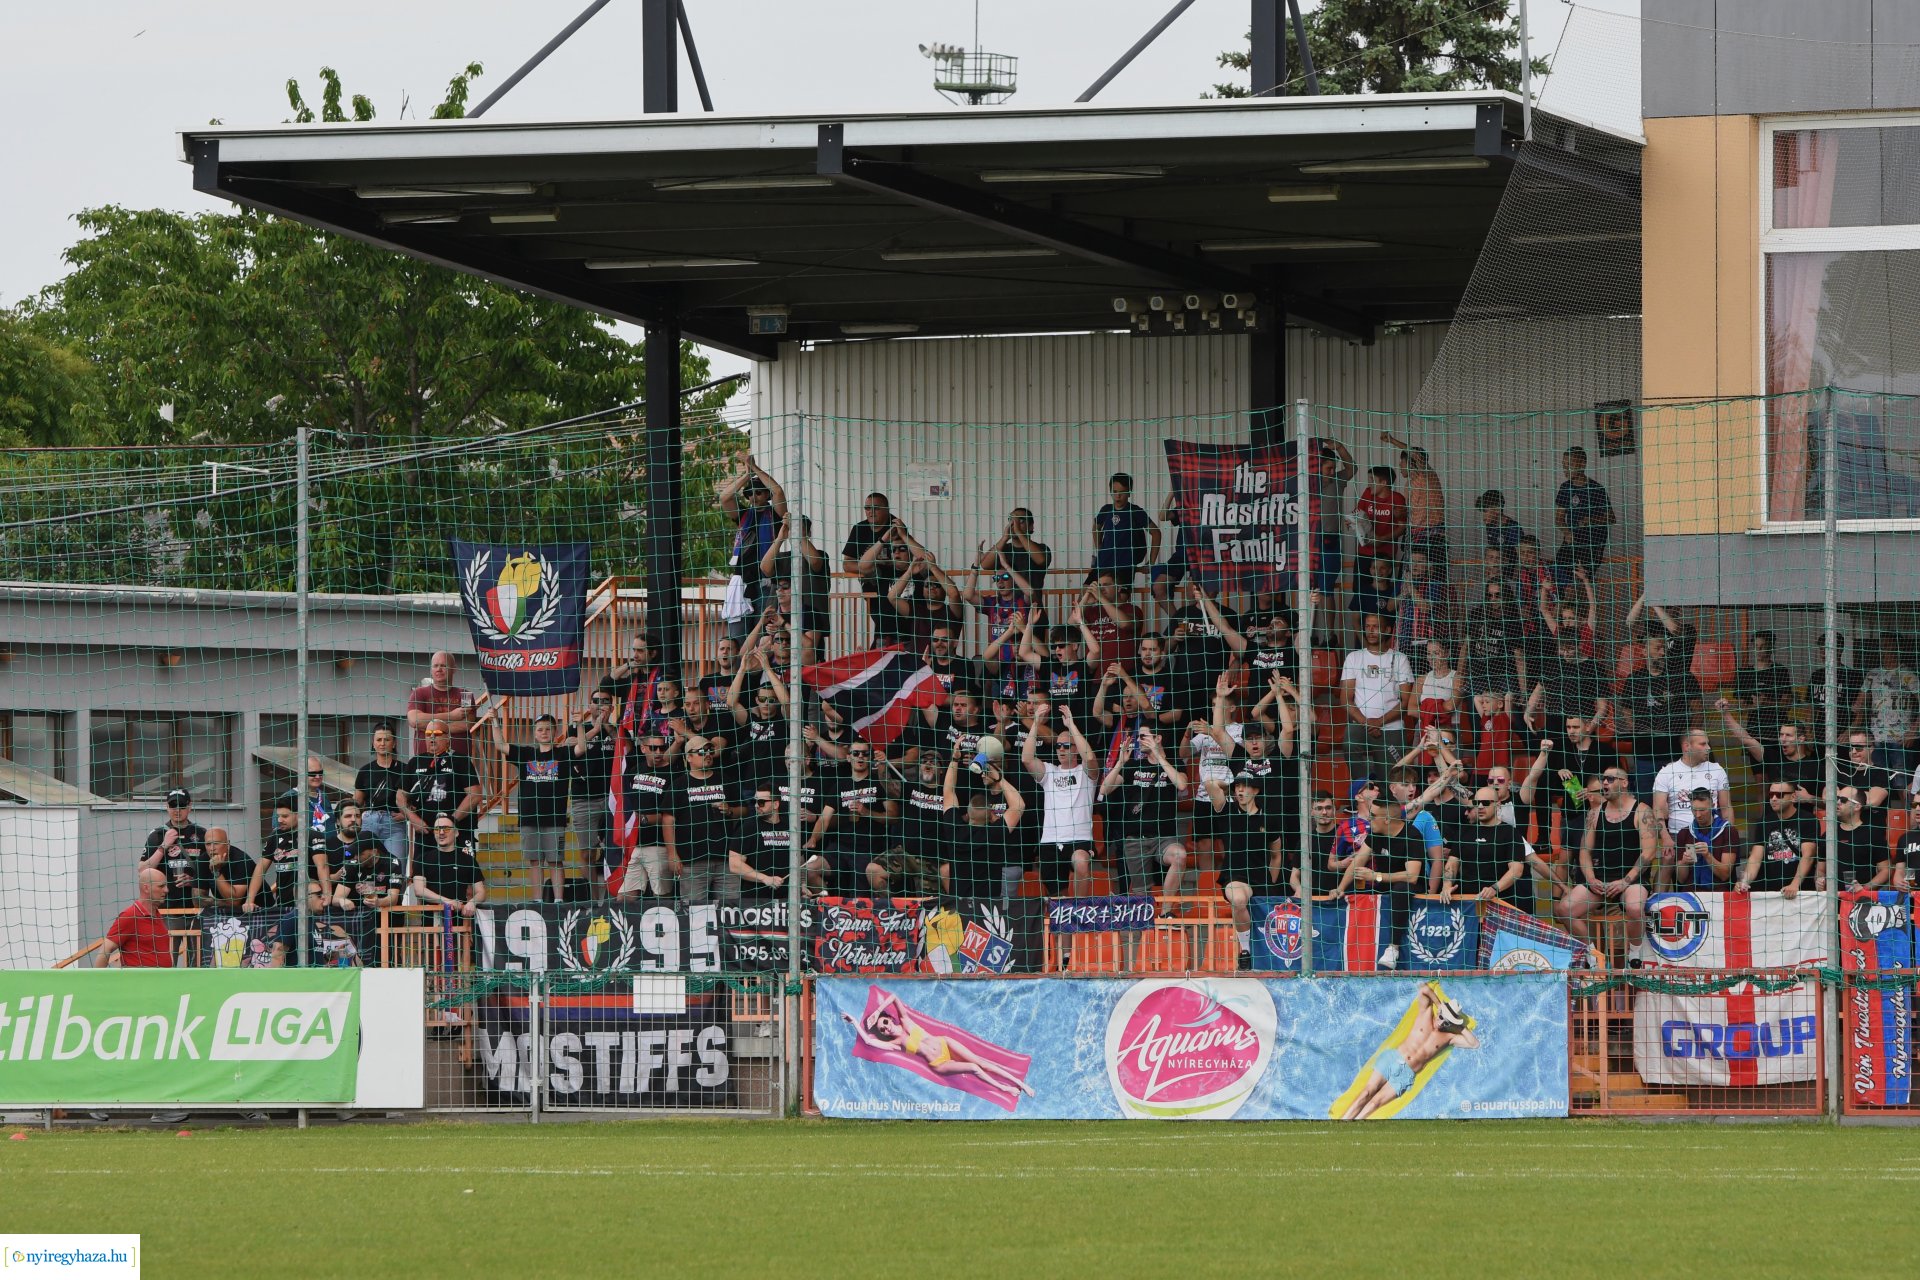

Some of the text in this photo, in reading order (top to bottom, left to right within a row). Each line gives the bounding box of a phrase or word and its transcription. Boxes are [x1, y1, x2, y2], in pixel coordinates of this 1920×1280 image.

[1234, 461, 1268, 494] the
[1201, 493, 1299, 527] Mastiffs
[1212, 528, 1287, 571] Family
[479, 650, 560, 669] Mastiffs 1995
[1420, 925, 1451, 938] 1928
[226, 1007, 334, 1045] LIGA
[1661, 1014, 1816, 1061] GROUP
[1117, 1014, 1258, 1101] Aquarius
[1167, 1057, 1254, 1069] NYÍREGYHÁZA
[1473, 1098, 1565, 1113] aquariusspa.hu
